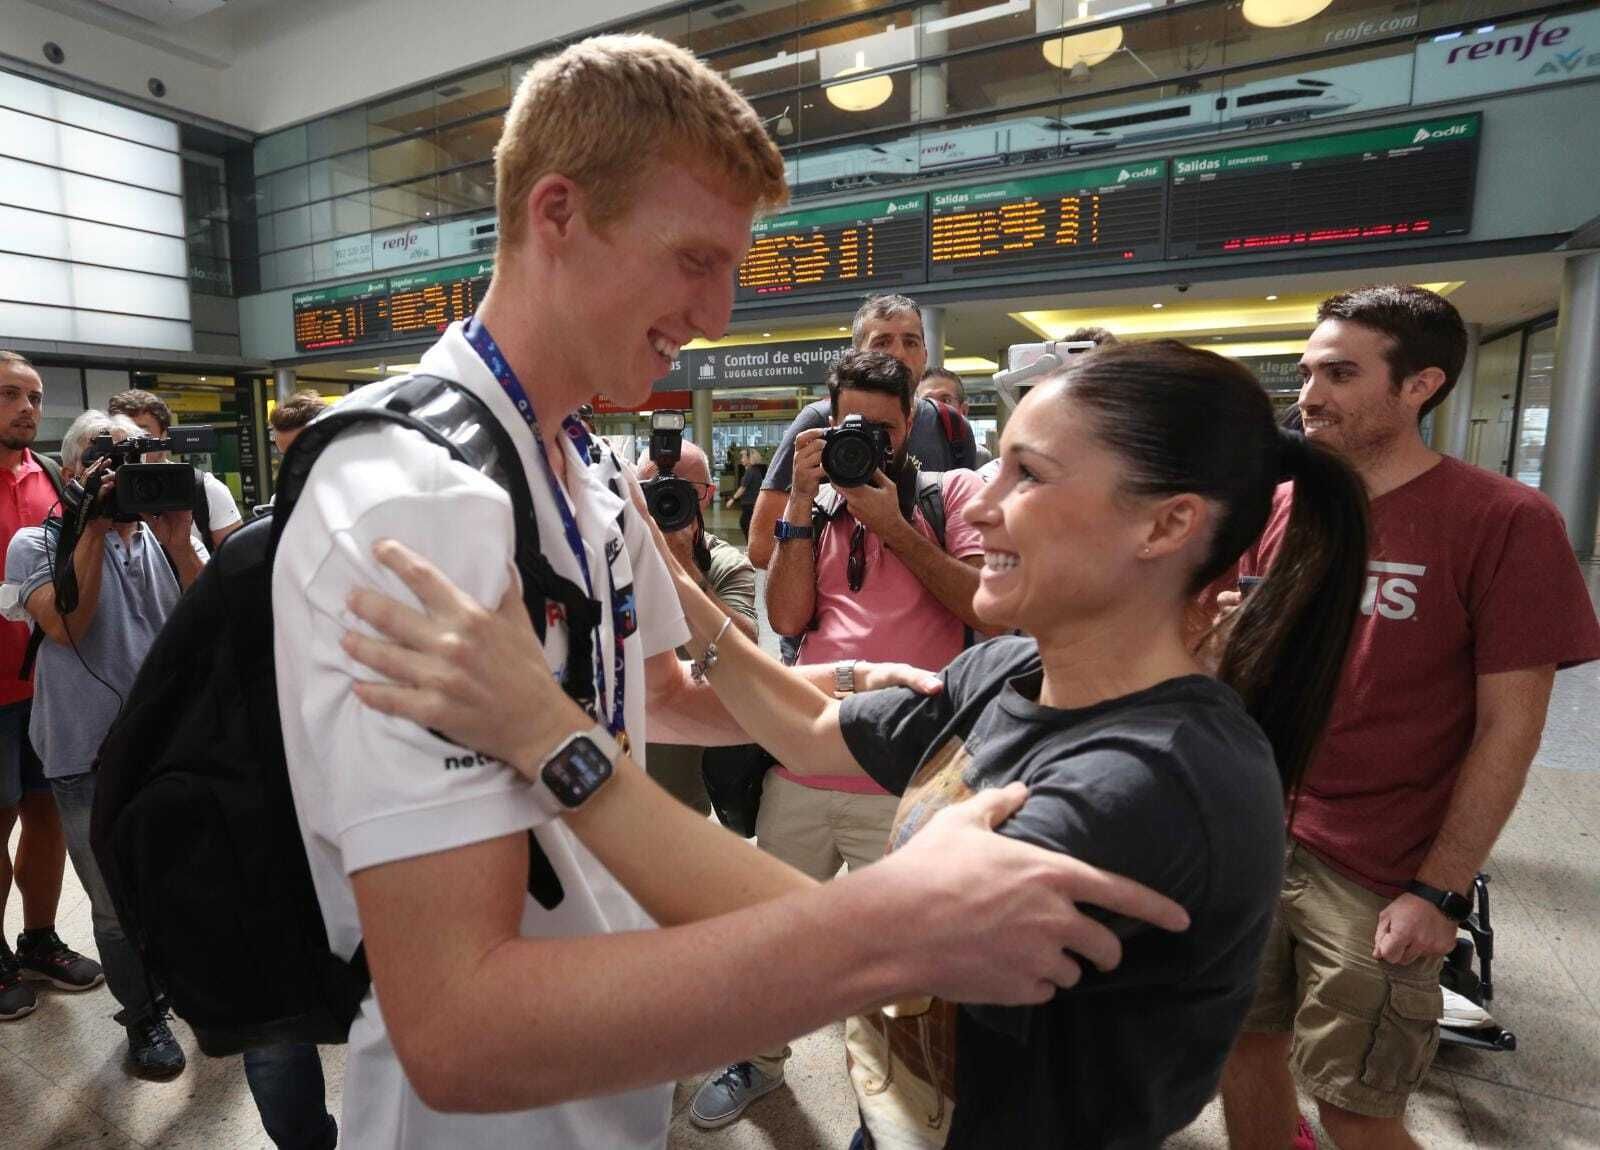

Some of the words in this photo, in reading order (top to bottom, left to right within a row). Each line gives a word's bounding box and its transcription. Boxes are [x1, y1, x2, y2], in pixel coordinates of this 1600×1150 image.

[1325, 15, 1418, 42] renfe.com
[1448, 20, 1570, 64] renfe
[1432, 125, 1467, 138] adif
[1131, 168, 1158, 178] adif
[1177, 160, 1220, 173] Salidas
[935, 194, 969, 206] Salidas
[383, 231, 418, 251] renfe
[725, 352, 768, 367] Control
[773, 351, 789, 364] de
[724, 368, 763, 378] LUGGAGE
[765, 366, 804, 376] CONTROL
[1260, 360, 1297, 375] Llega
[445, 752, 486, 770] net
